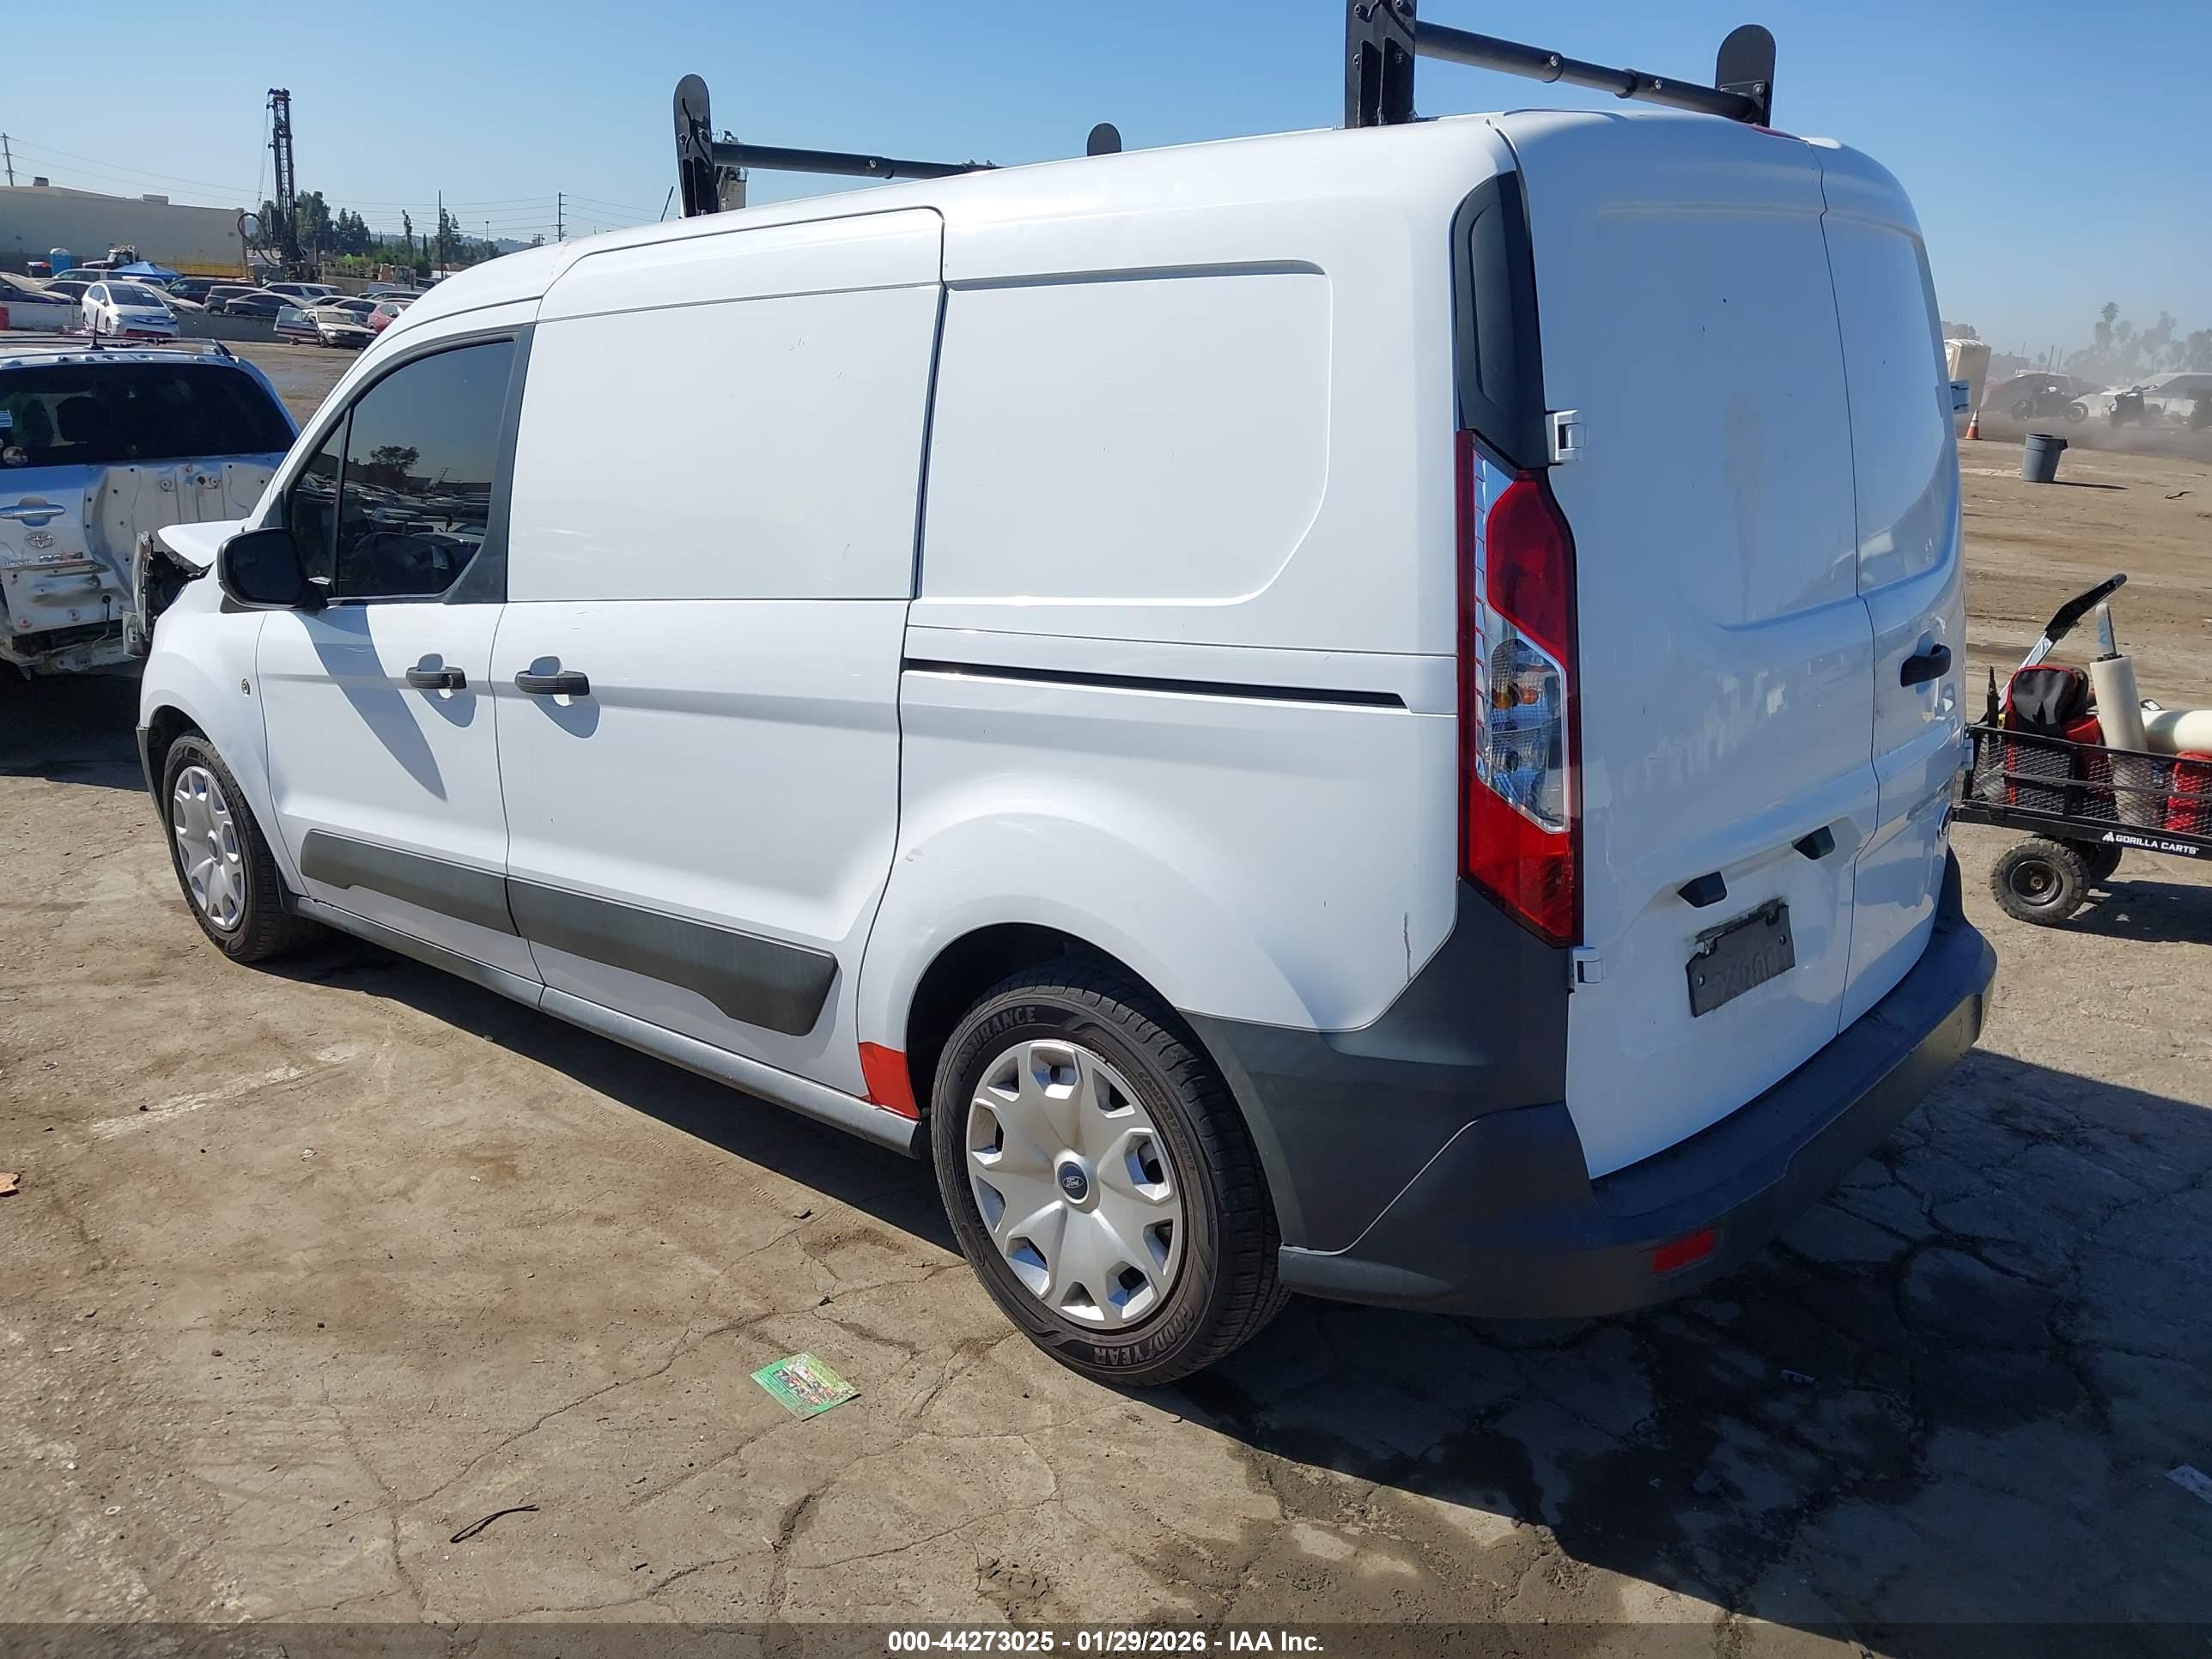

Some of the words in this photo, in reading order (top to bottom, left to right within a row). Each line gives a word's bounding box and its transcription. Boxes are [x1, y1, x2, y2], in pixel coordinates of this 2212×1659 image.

[2115, 834, 2158, 848] GORILLA
[2160, 842, 2197, 855] CARTS
[1094, 1304, 1194, 1365] GOODYEAR
